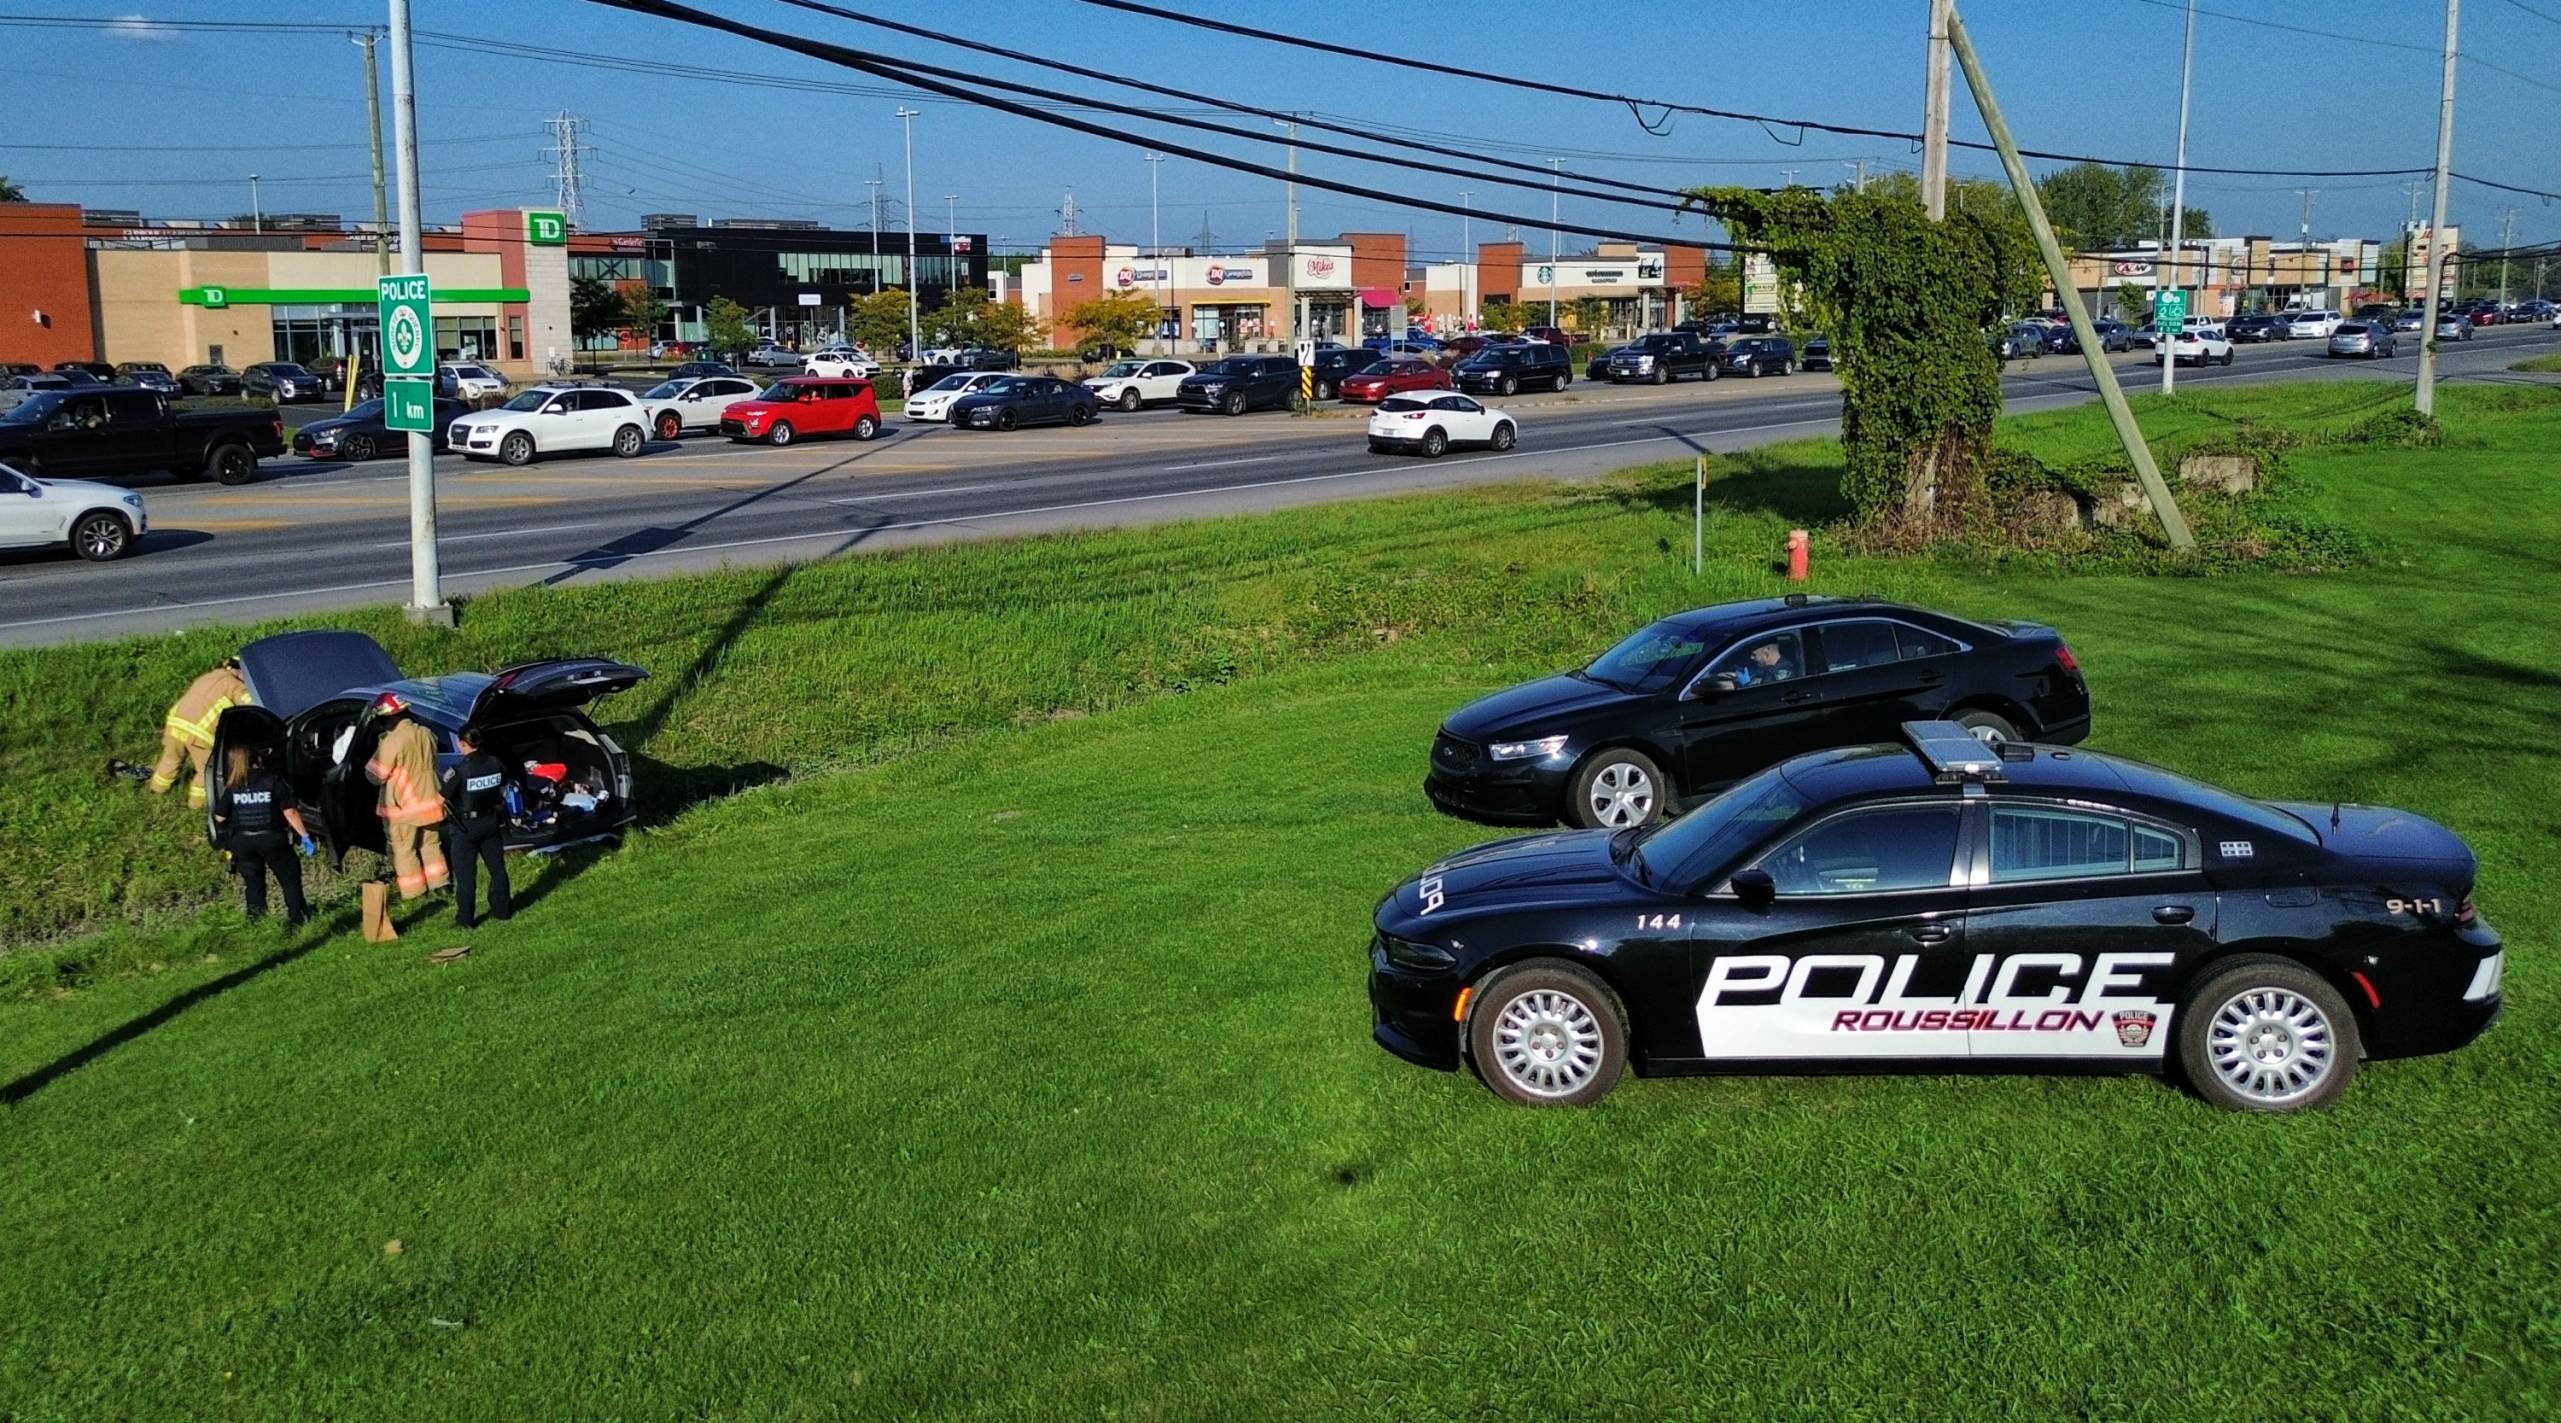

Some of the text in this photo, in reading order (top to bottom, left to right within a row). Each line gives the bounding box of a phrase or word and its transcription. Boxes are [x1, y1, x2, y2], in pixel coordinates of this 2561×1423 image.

[534, 218, 560, 238] TD
[1309, 259, 1334, 275] Mikes
[203, 289, 223, 302] TD
[381, 280, 426, 301] POLICE
[392, 391, 424, 419] 1 km
[469, 775, 501, 789] POLICE
[232, 791, 272, 804] POLICE
[2386, 898, 2441, 914] 9-1-1
[1637, 914, 1681, 930] 144
[1698, 953, 2176, 1005] POLICE
[1830, 1010, 2106, 1032] ROUSSILLON
